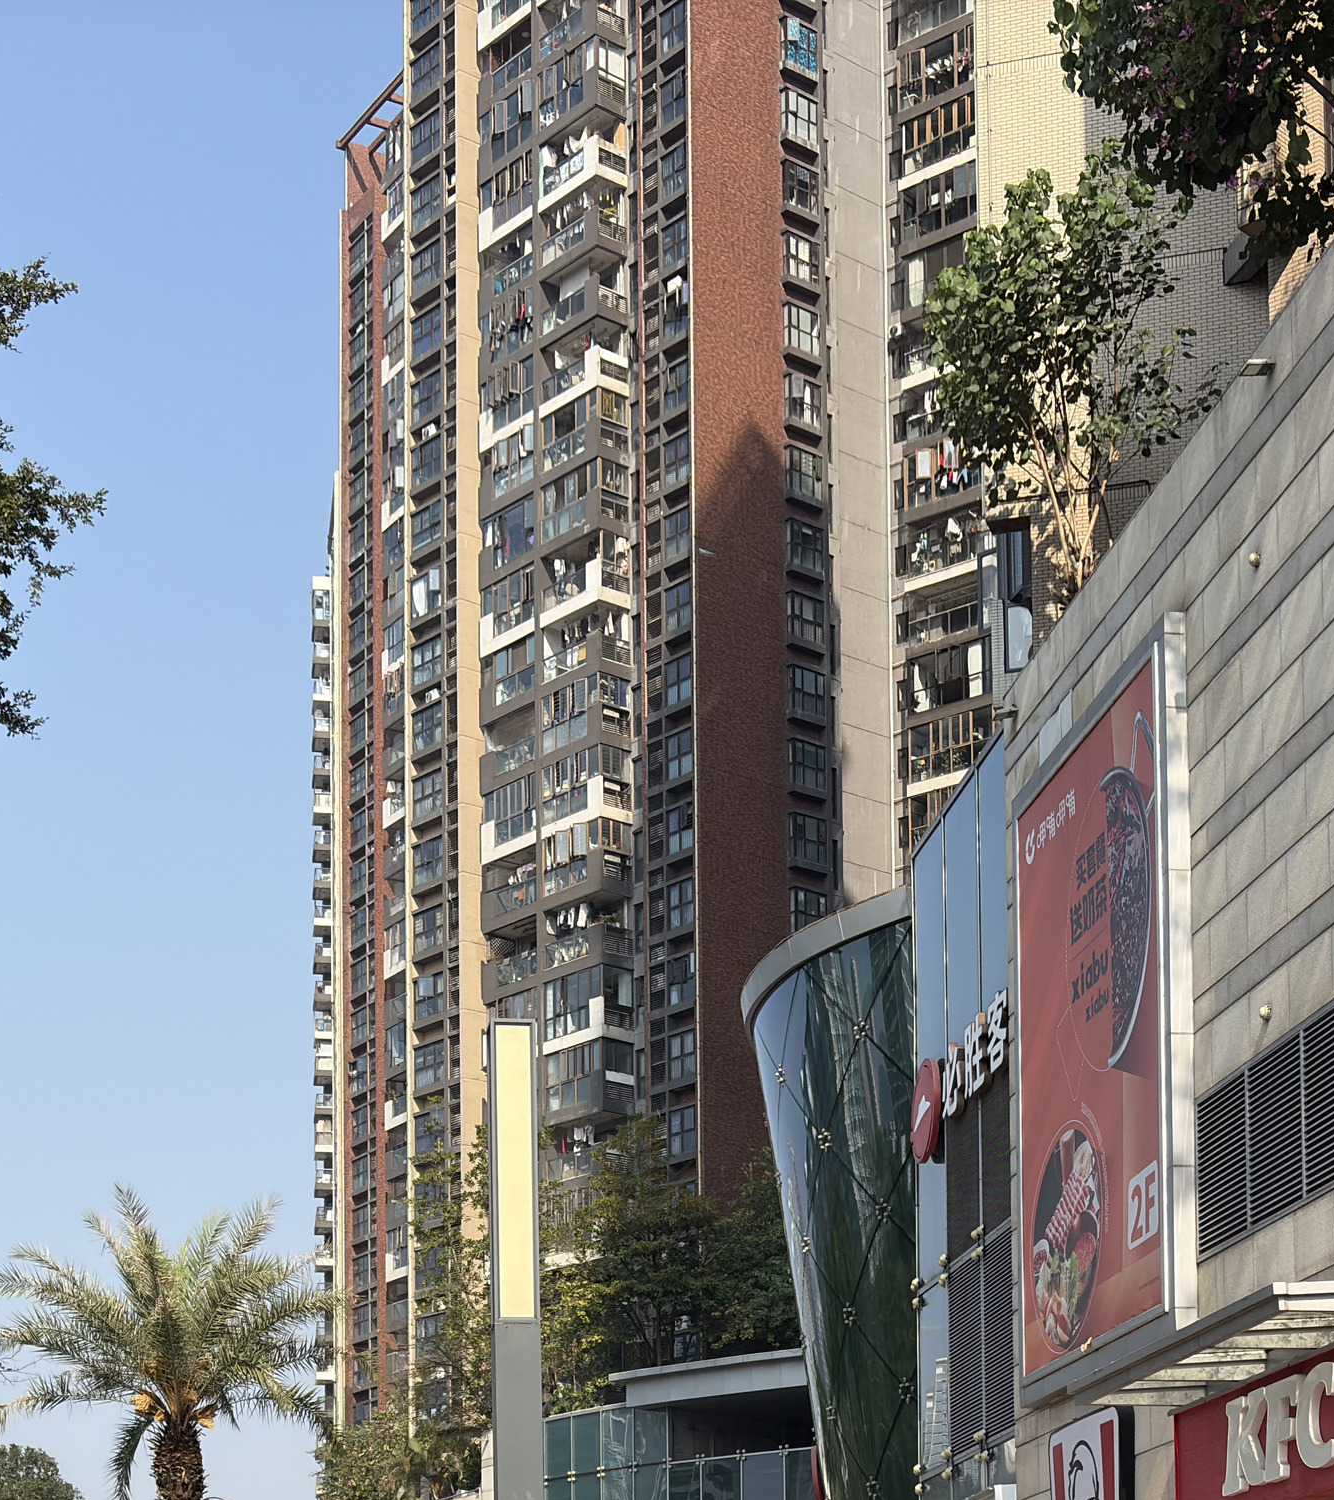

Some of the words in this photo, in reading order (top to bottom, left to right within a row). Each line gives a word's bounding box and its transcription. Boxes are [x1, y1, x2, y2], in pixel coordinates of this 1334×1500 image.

[1036, 788, 1076, 849] 呷哺呷哺
[1070, 874, 1107, 946] 送奶茶
[1071, 948, 1109, 1004] xiabu
[1085, 988, 1110, 1023] xiabu
[942, 988, 1008, 1119] 必胜客
[1130, 1170, 1156, 1243] 2F
